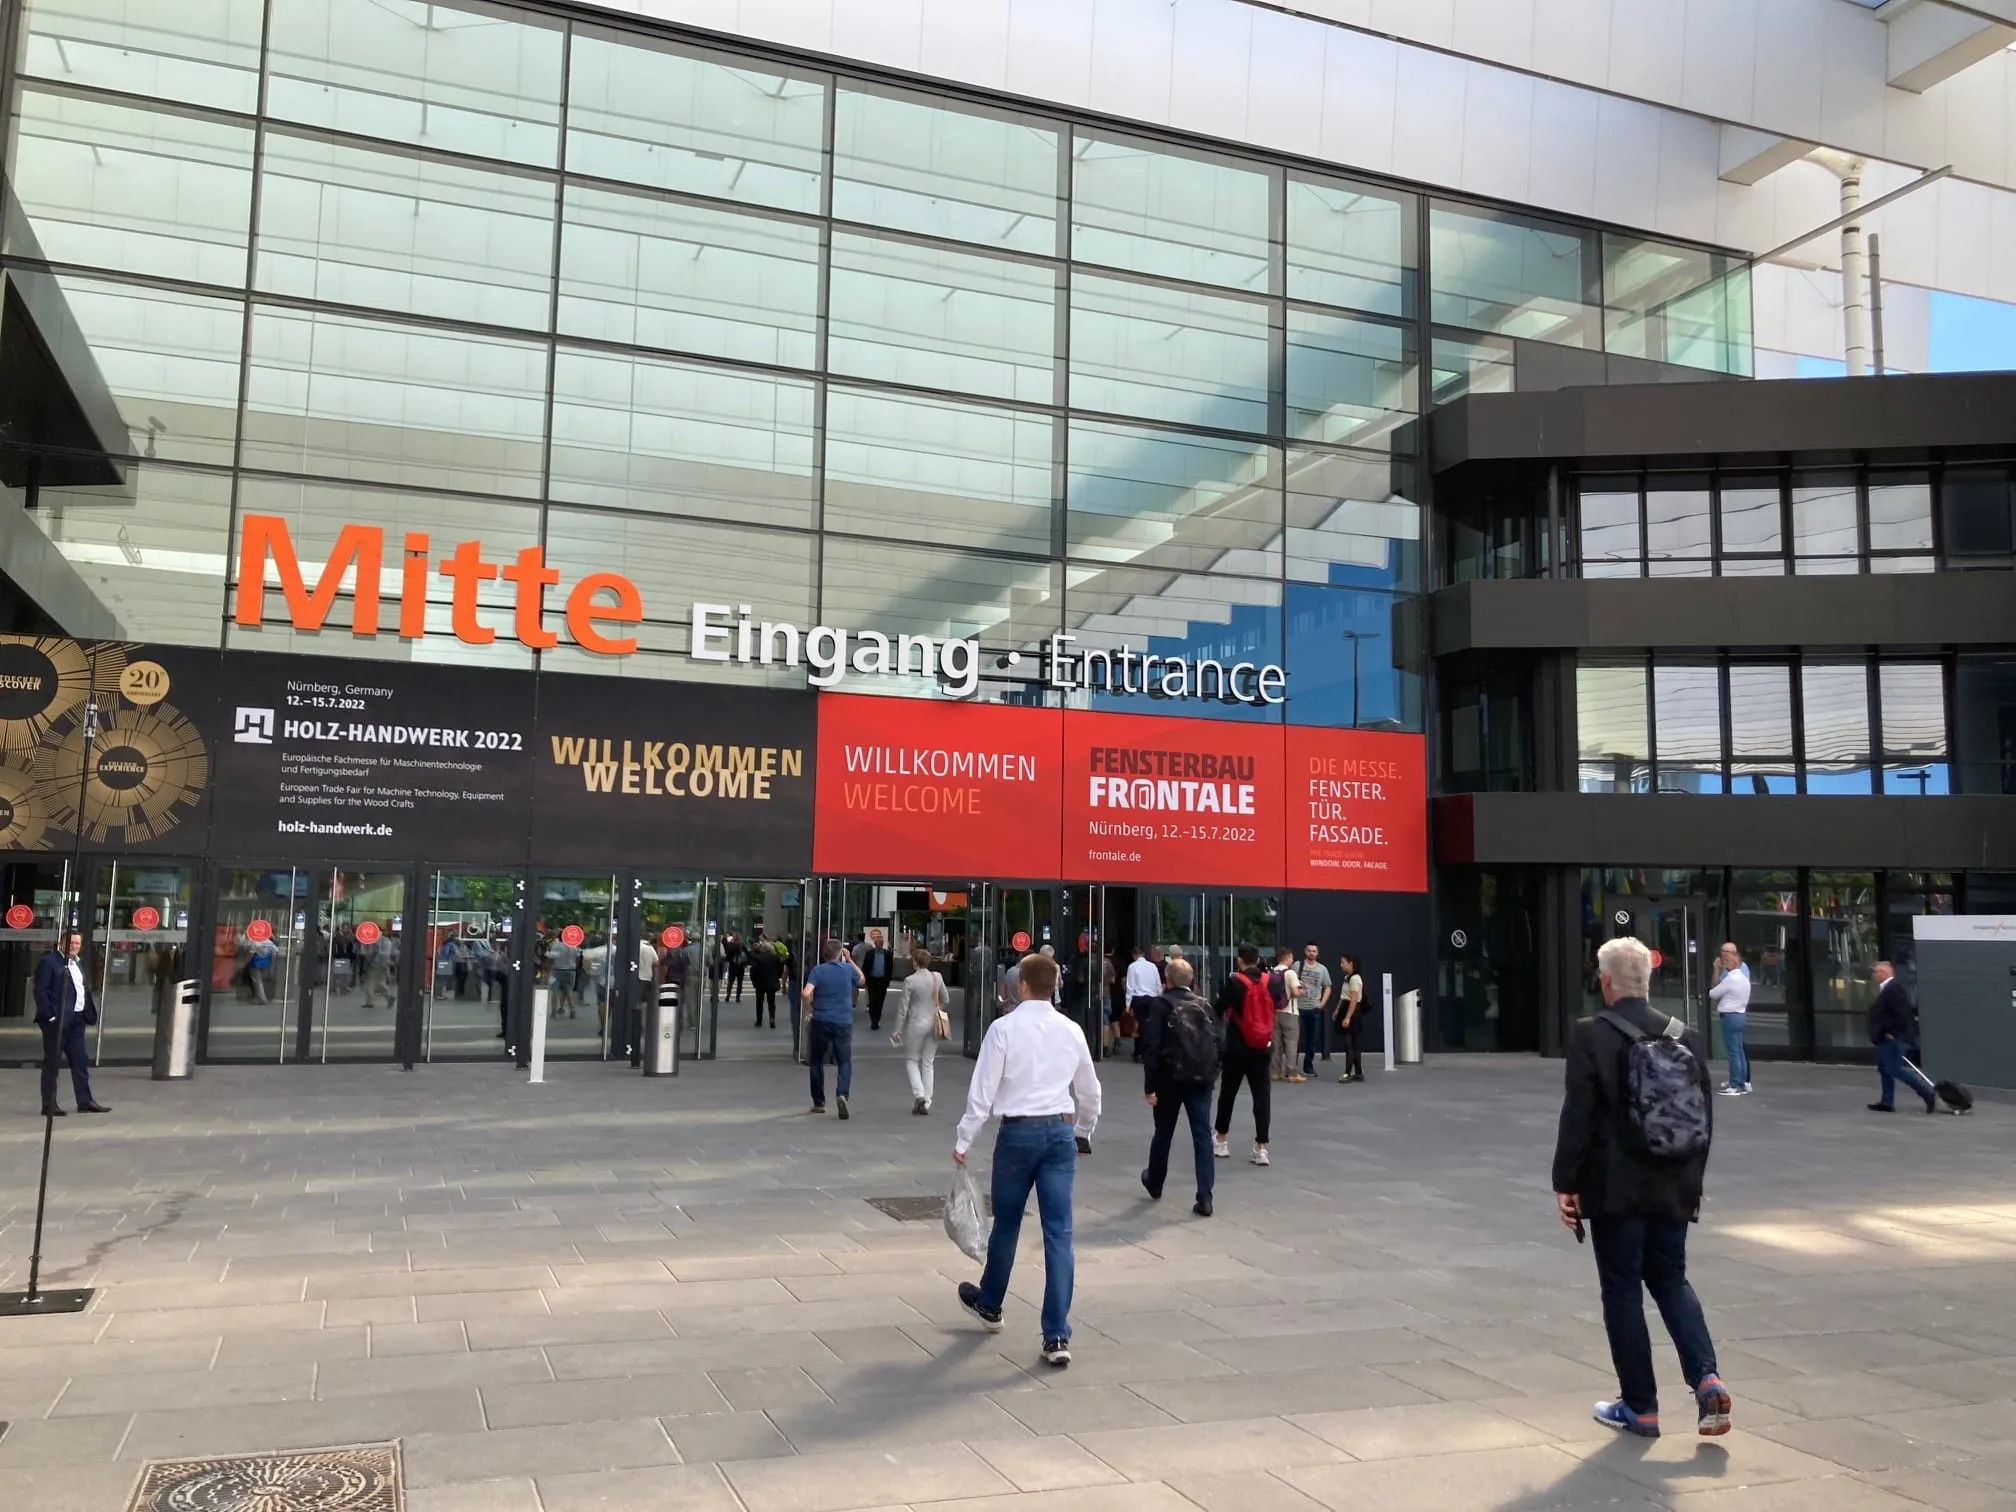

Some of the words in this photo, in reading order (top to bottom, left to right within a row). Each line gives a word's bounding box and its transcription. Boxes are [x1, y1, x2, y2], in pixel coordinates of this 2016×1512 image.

[236, 514, 642, 654] Mitte
[691, 602, 979, 696] Eingang
[1051, 634, 1286, 703] Entrance
[287, 680, 341, 695] Nürnberg,
[345, 684, 394, 699] Germany
[284, 720, 469, 748] HOLZ-HANDWERK
[474, 731, 523, 751] 2022
[282, 753, 331, 763] Europäische
[334, 755, 378, 766] Fachmesse
[380, 757, 392, 766] für
[393, 759, 482, 772] Maschinentechnologie
[551, 736, 802, 776] WILLKOMMEN
[845, 745, 1035, 781] WILLKOMMEN
[1090, 747, 1254, 780] FENSTERBAU
[281, 766, 298, 774] und
[300, 766, 369, 777] Fertigungsbedarf
[1309, 757, 1338, 775] DIE
[1343, 760, 1402, 779] MESSE.
[583, 762, 771, 799] WELCOME
[1309, 780, 1386, 800] FENSTER.
[279, 795, 296, 803] and
[297, 796, 331, 806] Supplies
[334, 796, 345, 805] for
[348, 798, 361, 806] the
[363, 799, 389, 807] Wood
[391, 799, 414, 808] Crafts
[280, 782, 319, 793] European
[322, 785, 344, 793] Trade
[346, 785, 361, 794] Fair
[363, 786, 375, 795] for
[377, 787, 412, 796] Machine
[414, 789, 460, 800] Technology,
[462, 791, 504, 802] Equipment
[844, 782, 981, 814] WELCOME
[1090, 776, 1255, 814] FRONTALE
[1308, 799, 1347, 820] TÜR.
[278, 820, 393, 836] holz-handwerk.de
[1089, 821, 1158, 839] Nürnberg,
[1309, 824, 1388, 845] FASSADE.
[1089, 850, 1141, 862] frontale.de
